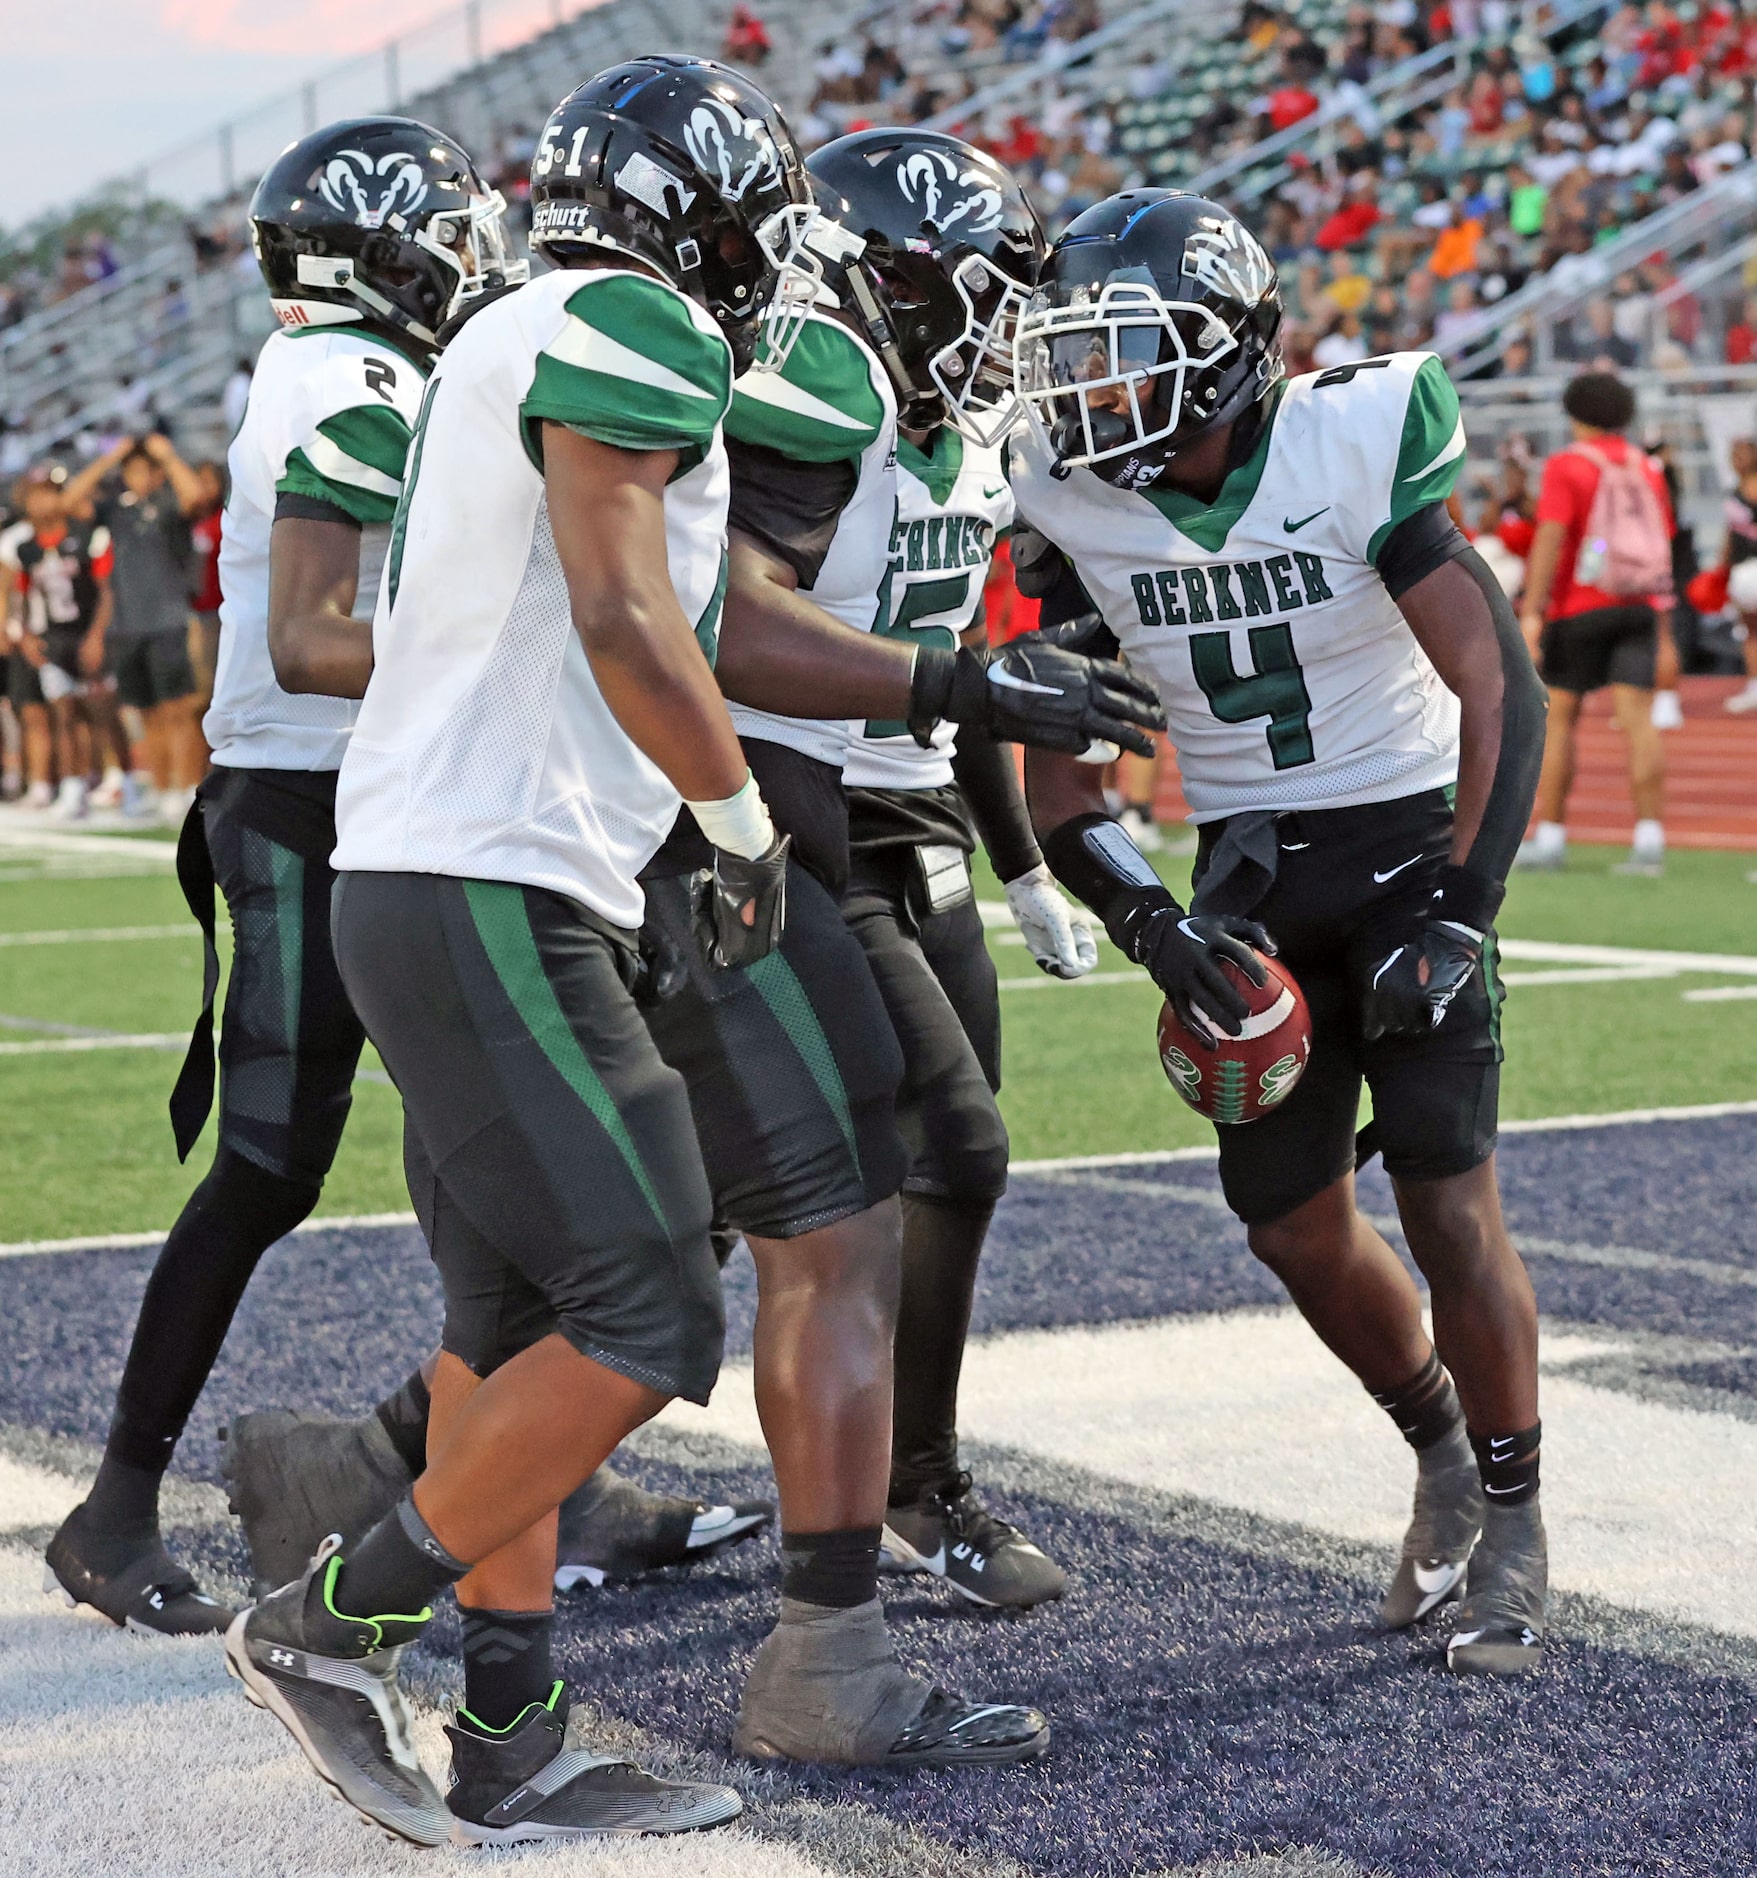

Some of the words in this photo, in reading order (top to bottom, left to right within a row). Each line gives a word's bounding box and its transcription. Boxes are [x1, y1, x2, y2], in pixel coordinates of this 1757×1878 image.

[536, 125, 589, 177] 51
[534, 202, 589, 229] schutt
[363, 357, 397, 404] 2
[1311, 359, 1393, 390] 4
[1130, 551, 1334, 627] BERKNER
[1188, 621, 1316, 771] 4
